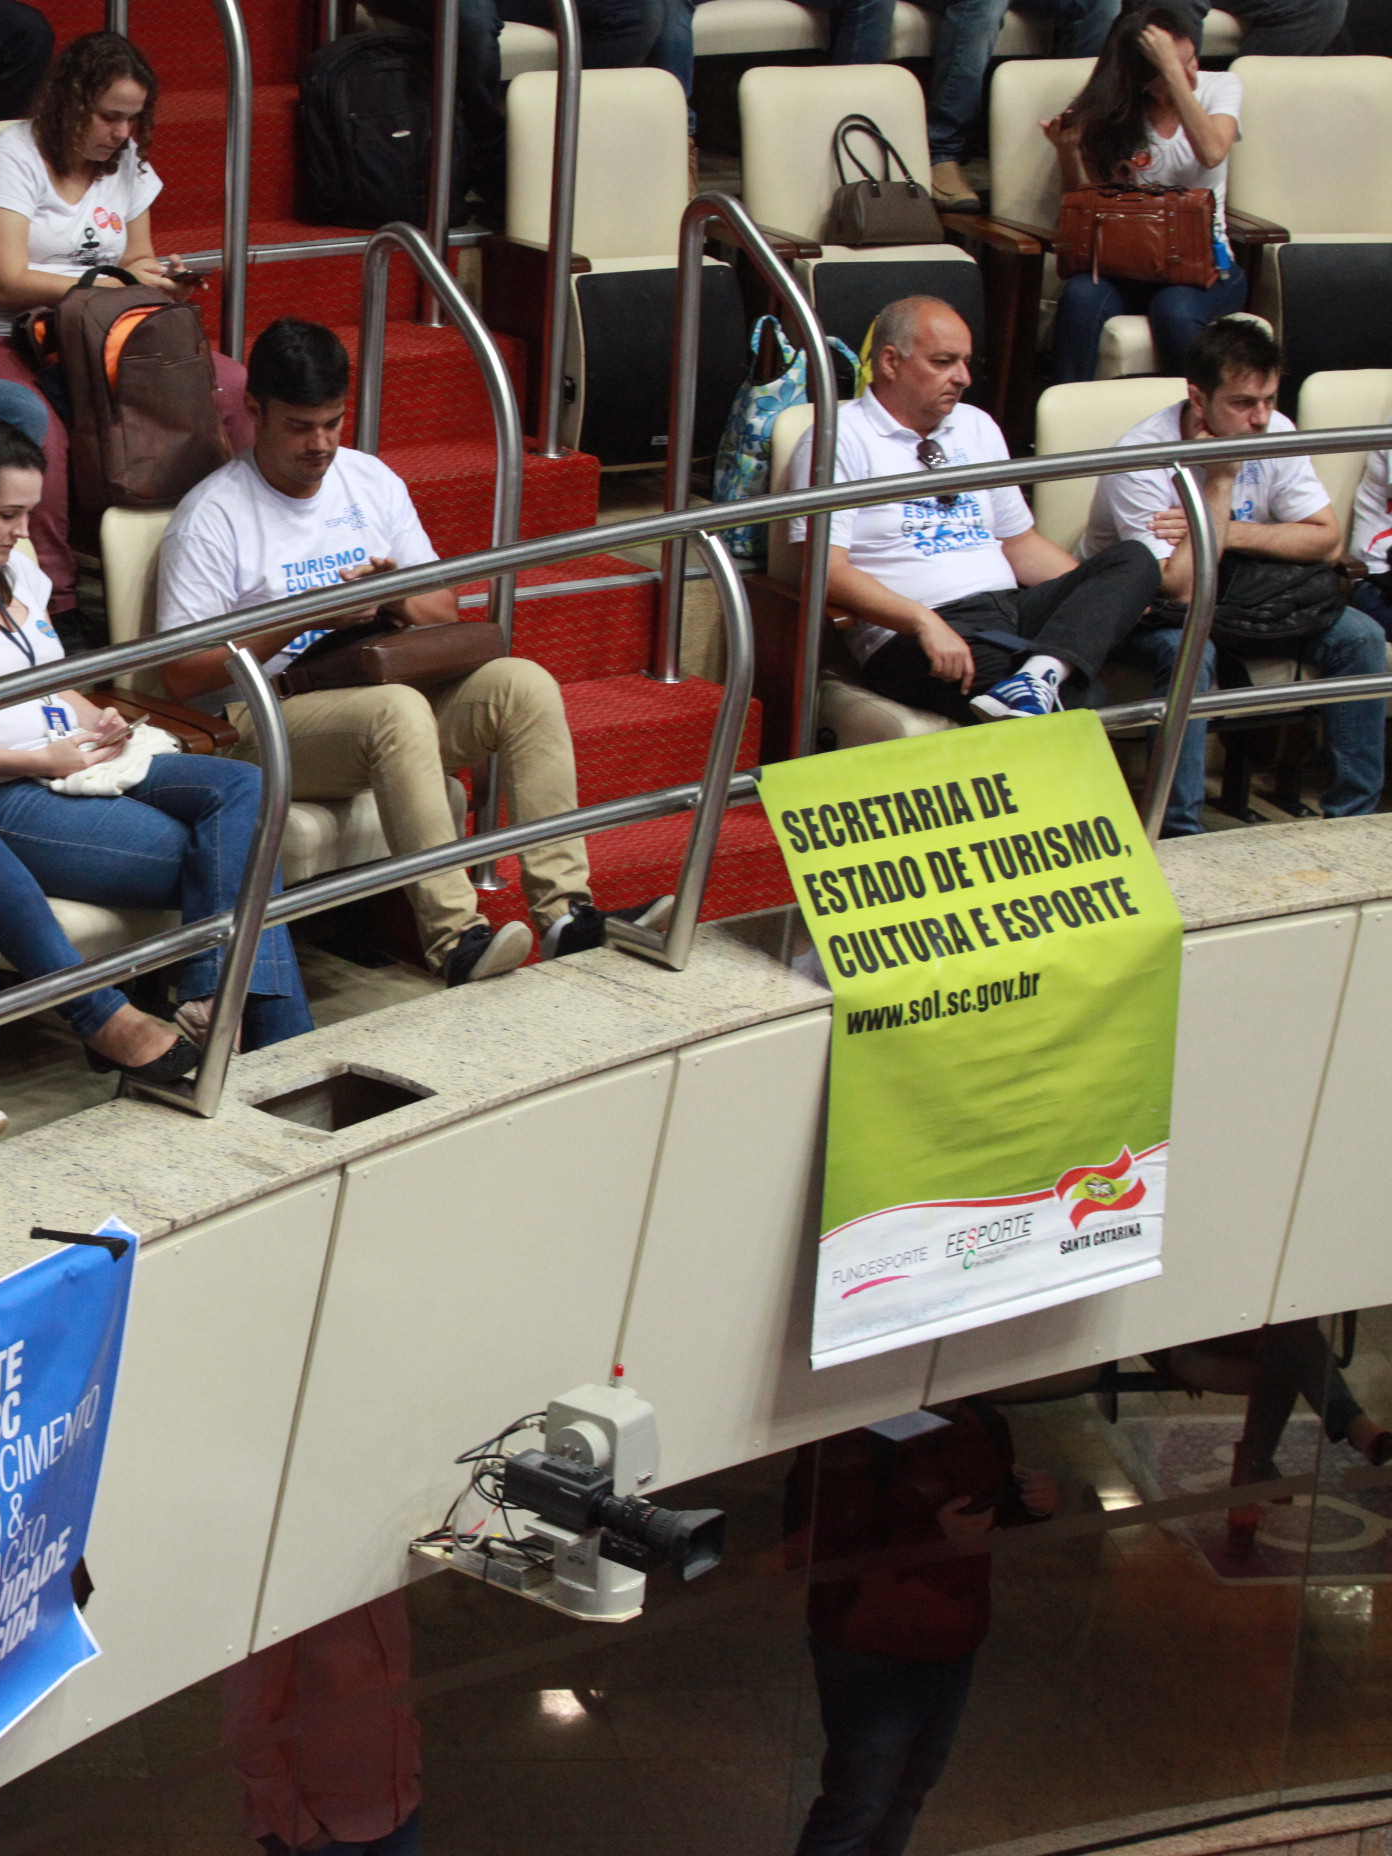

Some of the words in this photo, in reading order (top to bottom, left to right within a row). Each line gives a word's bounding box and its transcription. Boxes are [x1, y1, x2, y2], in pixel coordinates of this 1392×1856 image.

[903, 503, 981, 519] ESPORTE
[281, 547, 366, 577] TURISMO
[286, 566, 348, 593] CULTU
[781, 781, 974, 853] SECRETARIA
[970, 772, 1019, 819] DE
[802, 855, 926, 916] ESTADO
[925, 846, 975, 894] DE
[970, 815, 1133, 880] TURISMO,
[828, 912, 976, 978] CULTURA
[969, 907, 999, 948] E
[995, 876, 1140, 942] ESPORTE
[846, 971, 1041, 1035] www.sol.sc.gov.br
[946, 1212, 1034, 1254] FESPORTE
[1060, 1234, 1091, 1255] SANTA
[1094, 1222, 1143, 1247] CATARINA
[831, 1246, 929, 1286] FUNDESPORTE
[6, 1493, 26, 1537] &
